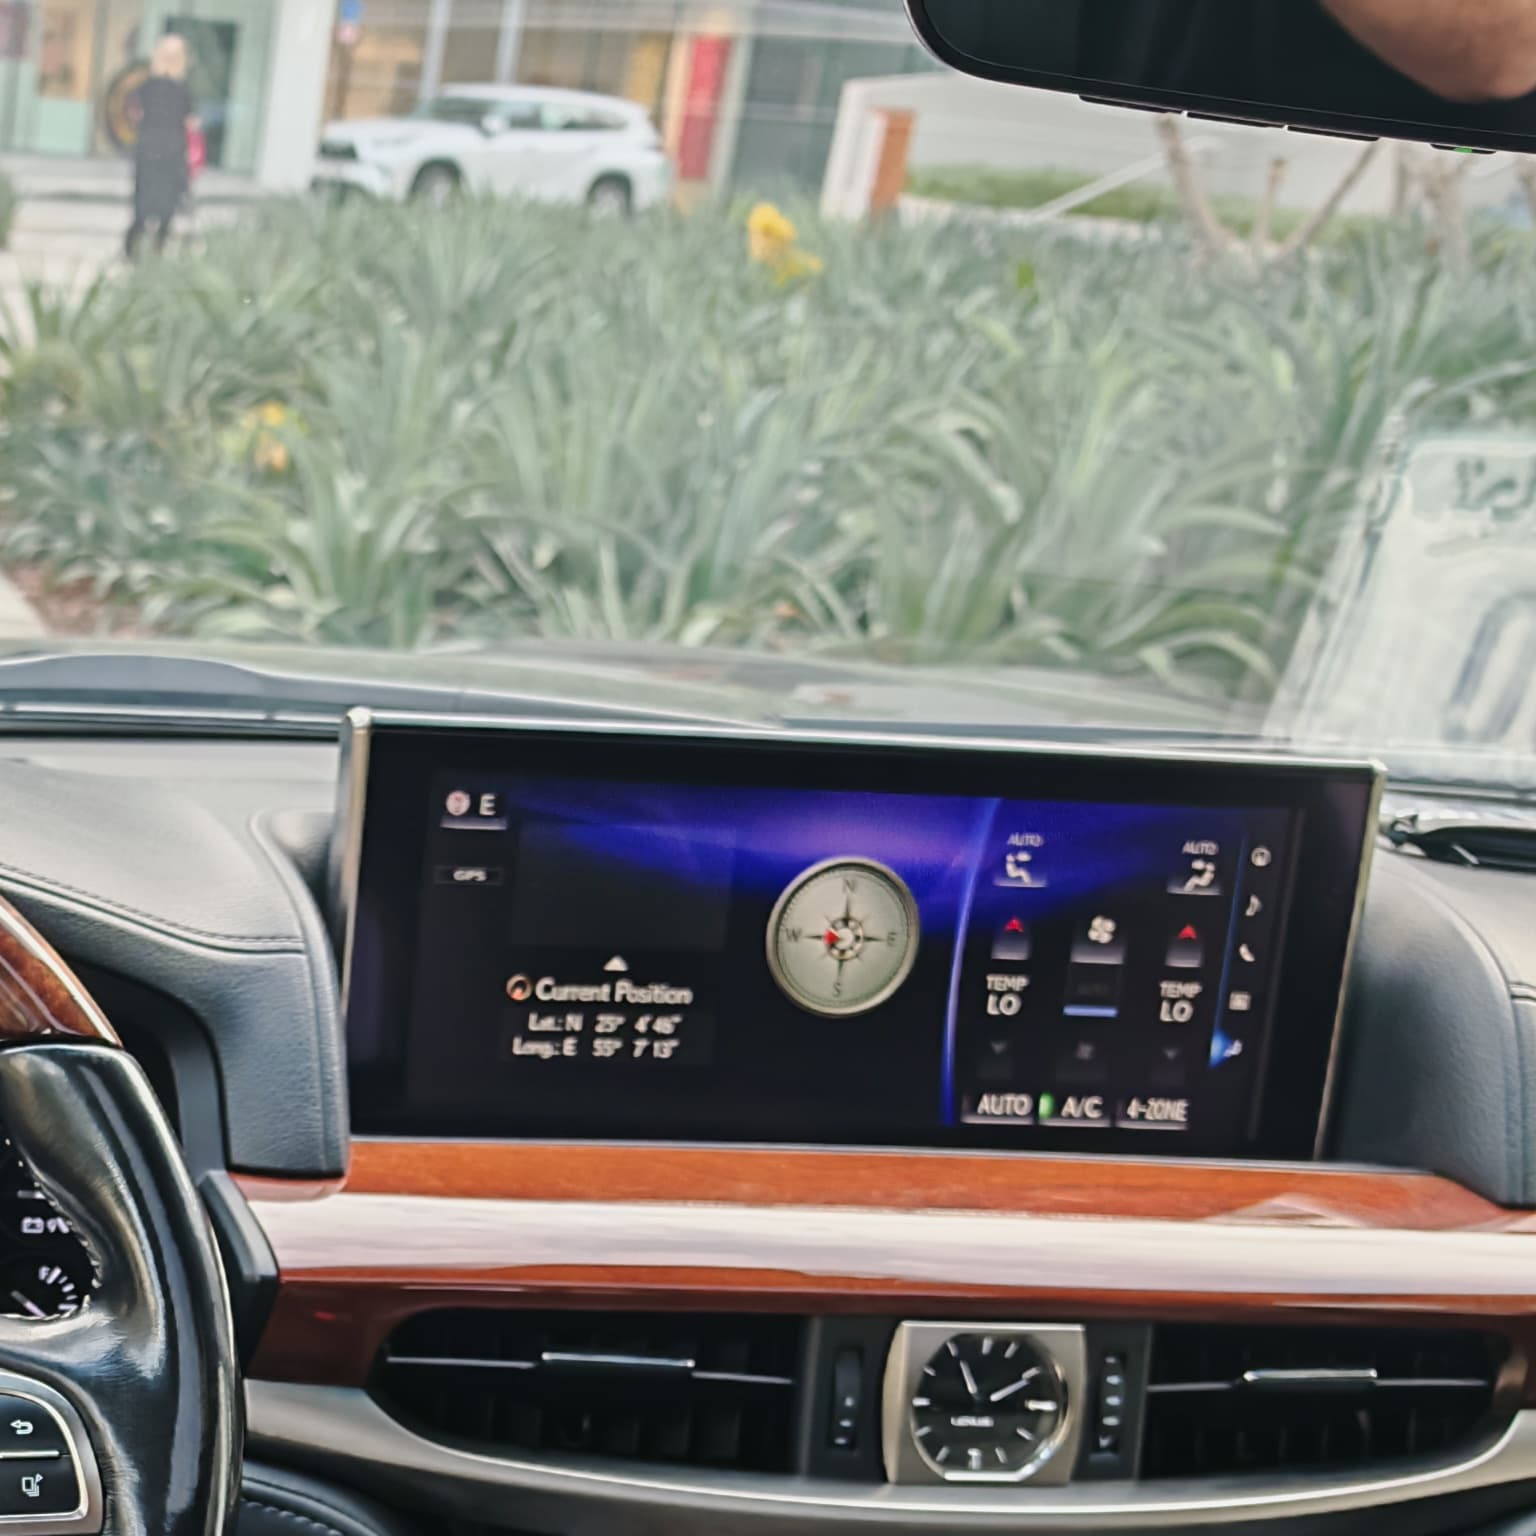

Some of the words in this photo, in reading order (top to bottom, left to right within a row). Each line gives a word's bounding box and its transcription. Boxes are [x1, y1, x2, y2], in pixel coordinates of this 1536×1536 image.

[534, 976, 611, 1003] Current
[614, 979, 694, 1005] Position
[985, 973, 1030, 991] TEMP
[1159, 979, 1202, 999] TEMP
[986, 993, 1022, 1016] LO
[1159, 999, 1194, 1023] LO
[976, 1093, 1033, 1117] AUTO
[1060, 1096, 1104, 1119] A/C
[1126, 1097, 1189, 1122] 4-ZONE
